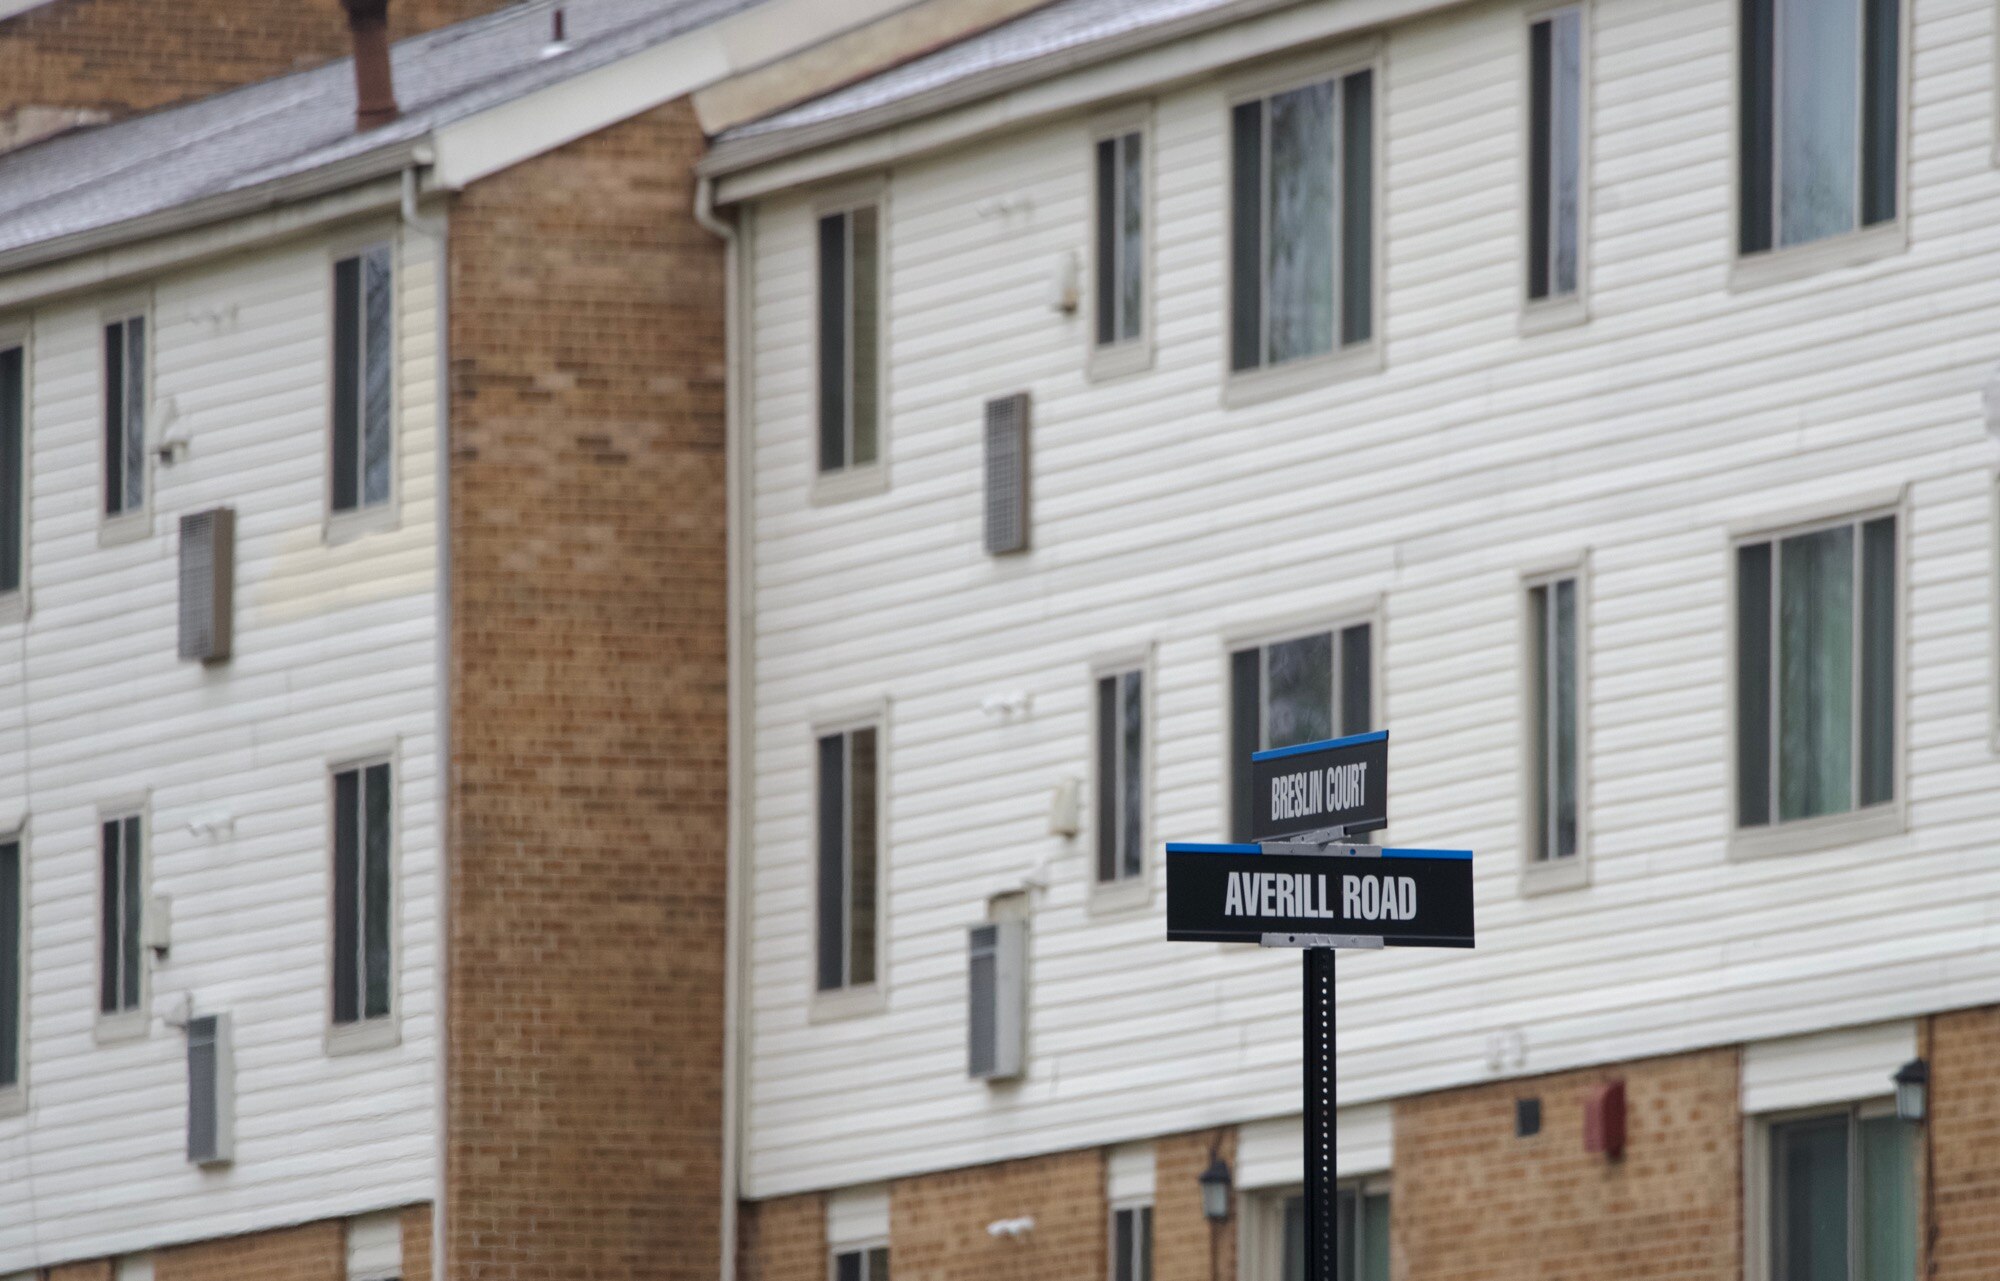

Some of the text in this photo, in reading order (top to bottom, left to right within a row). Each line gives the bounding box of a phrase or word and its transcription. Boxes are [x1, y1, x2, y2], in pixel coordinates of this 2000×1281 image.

[1271, 762, 1368, 821] BRESLIN COURT
[1224, 871, 1417, 921] AVERILL ROAD
